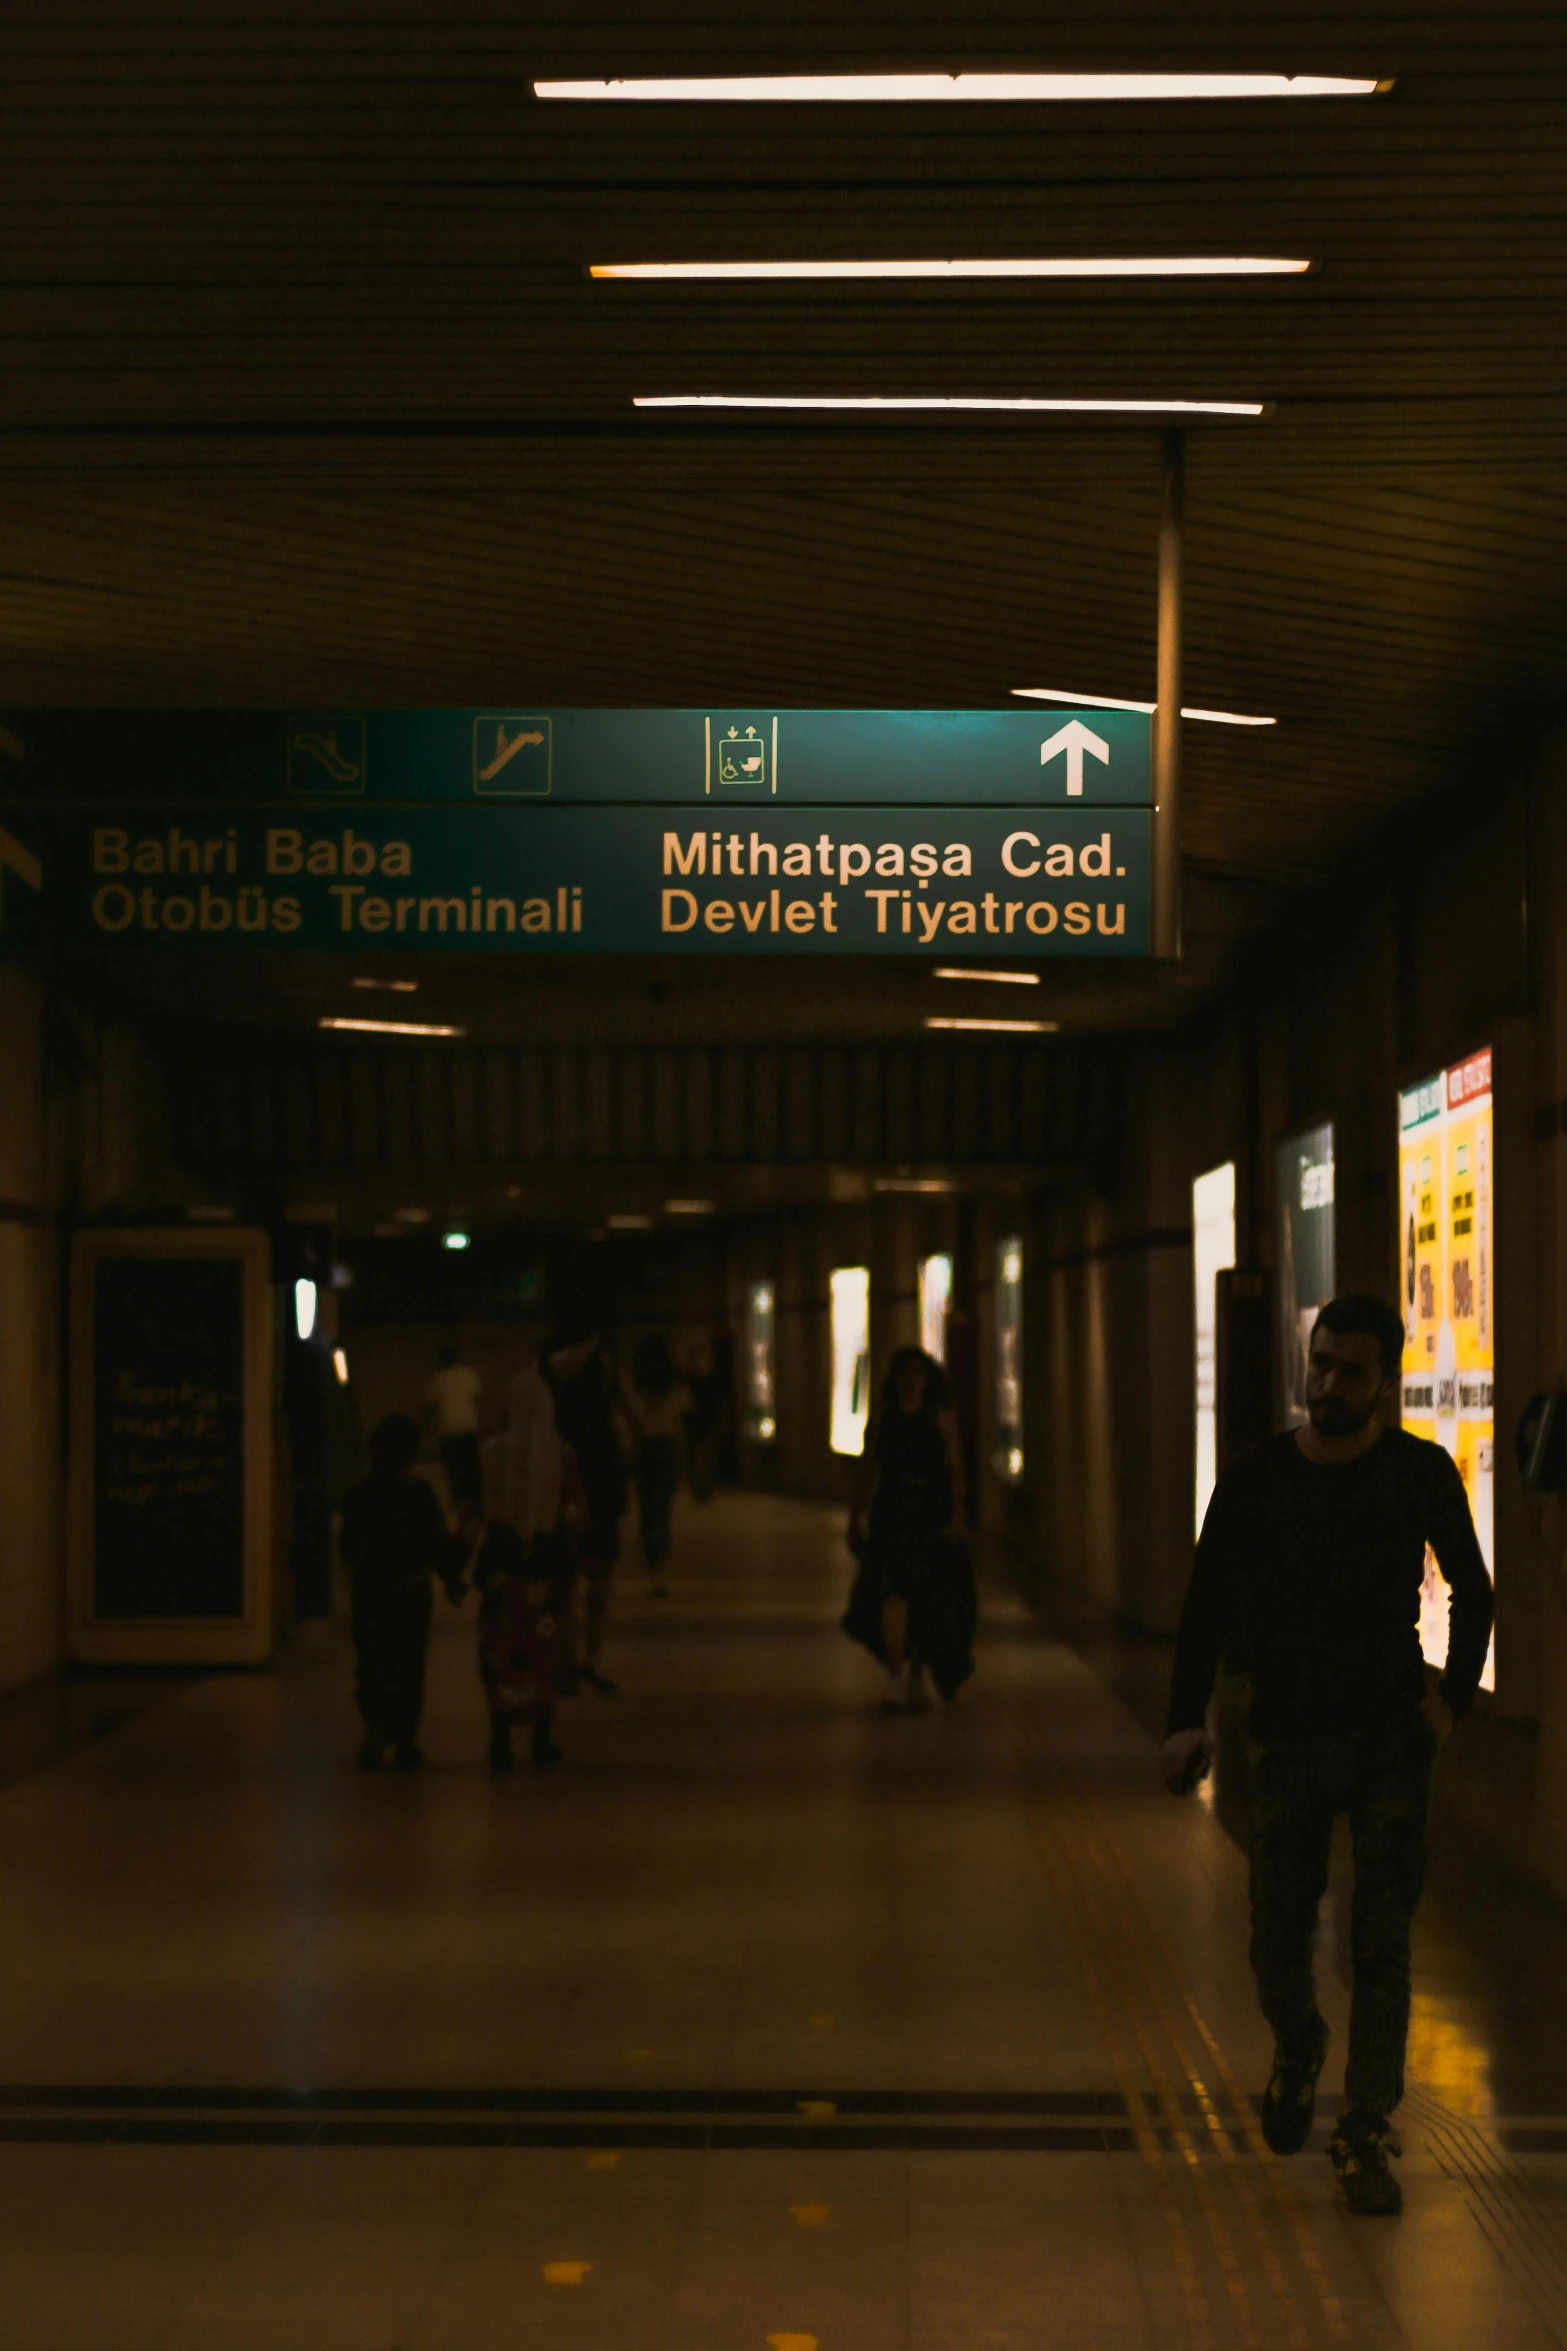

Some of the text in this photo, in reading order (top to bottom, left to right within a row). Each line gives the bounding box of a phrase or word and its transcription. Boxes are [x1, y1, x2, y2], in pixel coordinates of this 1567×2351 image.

[92, 828, 412, 876] Bahri Baba
[662, 830, 1127, 890] Mithatpaşa Cad.
[92, 884, 583, 934] Otobüs Terminali
[662, 887, 1127, 943] Devlet Tiyatrosu
